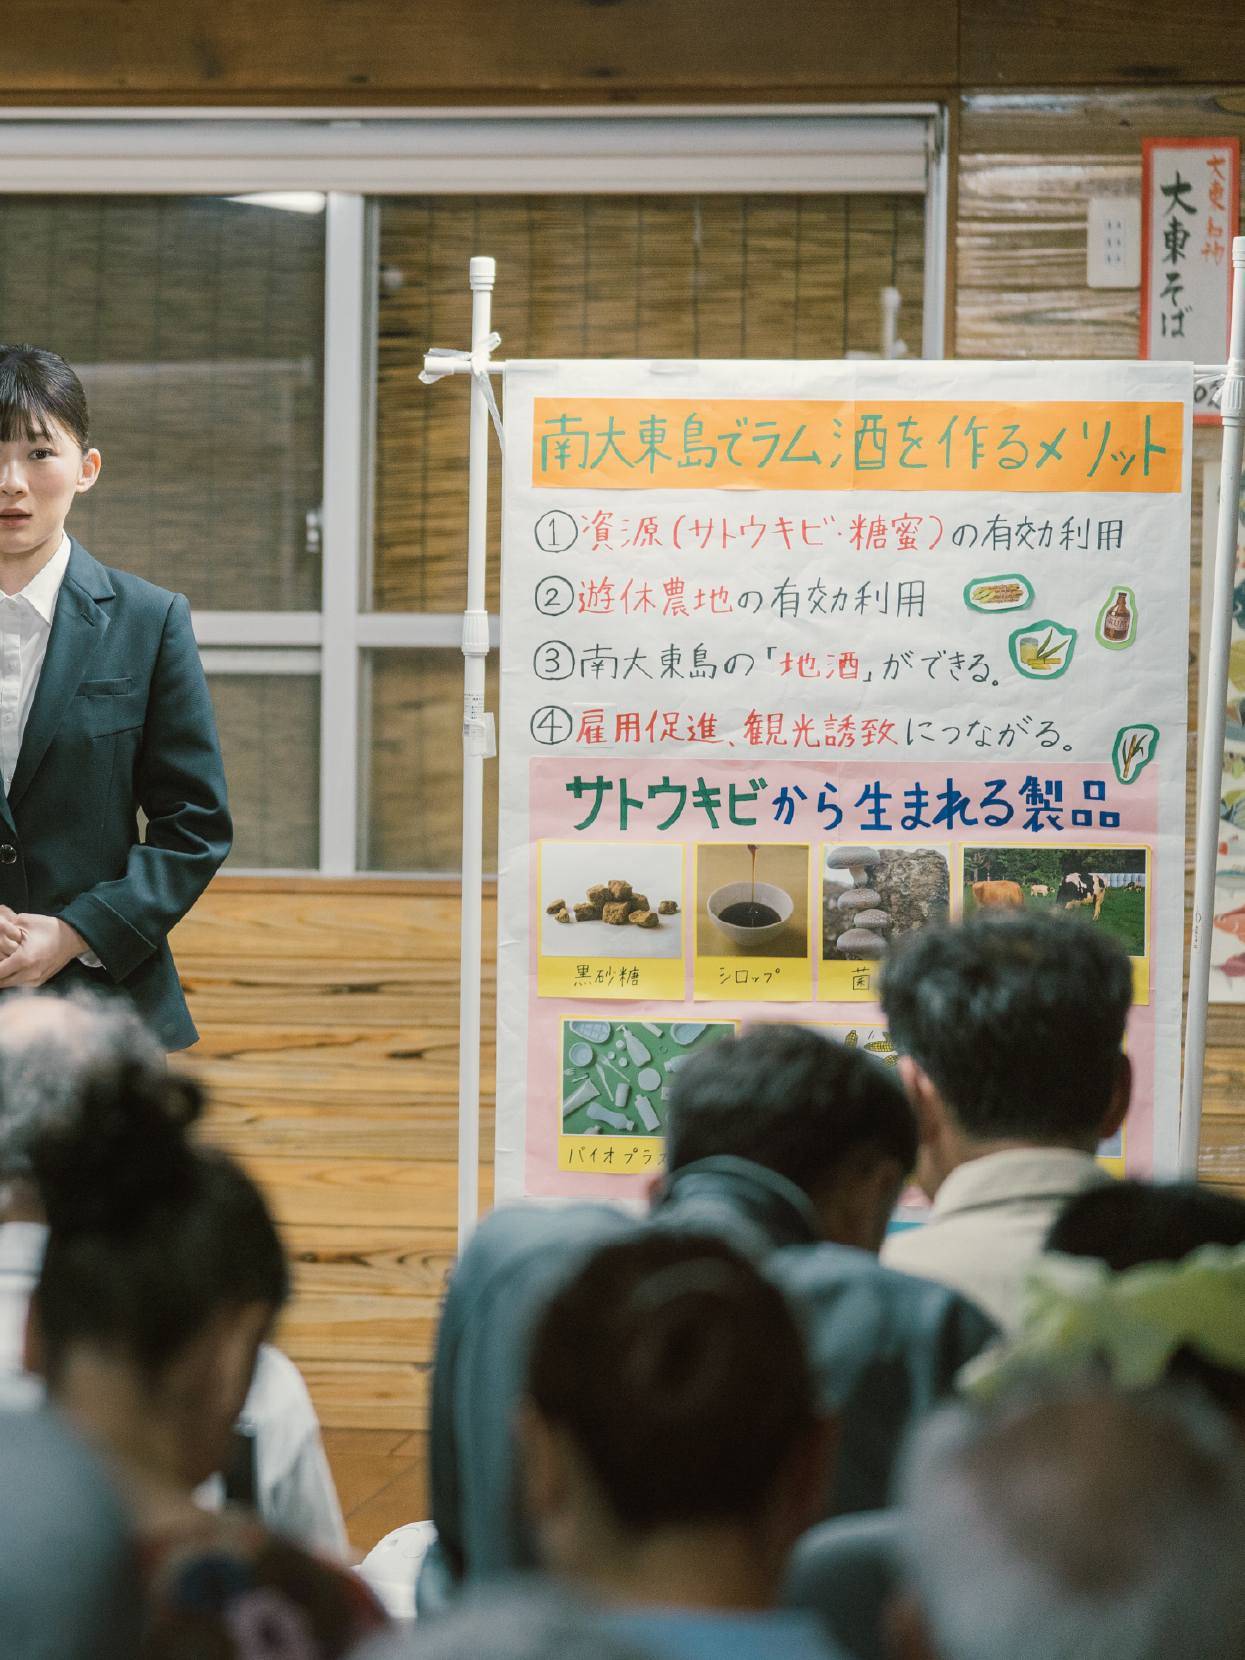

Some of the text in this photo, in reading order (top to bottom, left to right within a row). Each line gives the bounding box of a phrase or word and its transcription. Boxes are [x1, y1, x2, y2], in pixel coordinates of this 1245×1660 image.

[1160, 169, 1197, 338] 大東そば
[539, 412, 1167, 478] 南大東島でラム酒を作るメリット
[535, 575, 925, 617] ②遊休農地の有効利用
[1107, 618, 1129, 628] RUM
[566, 775, 1122, 833] サトウキビから生まれる製品
[573, 965, 640, 988] 黒砂糖
[719, 967, 781, 985] シロップ
